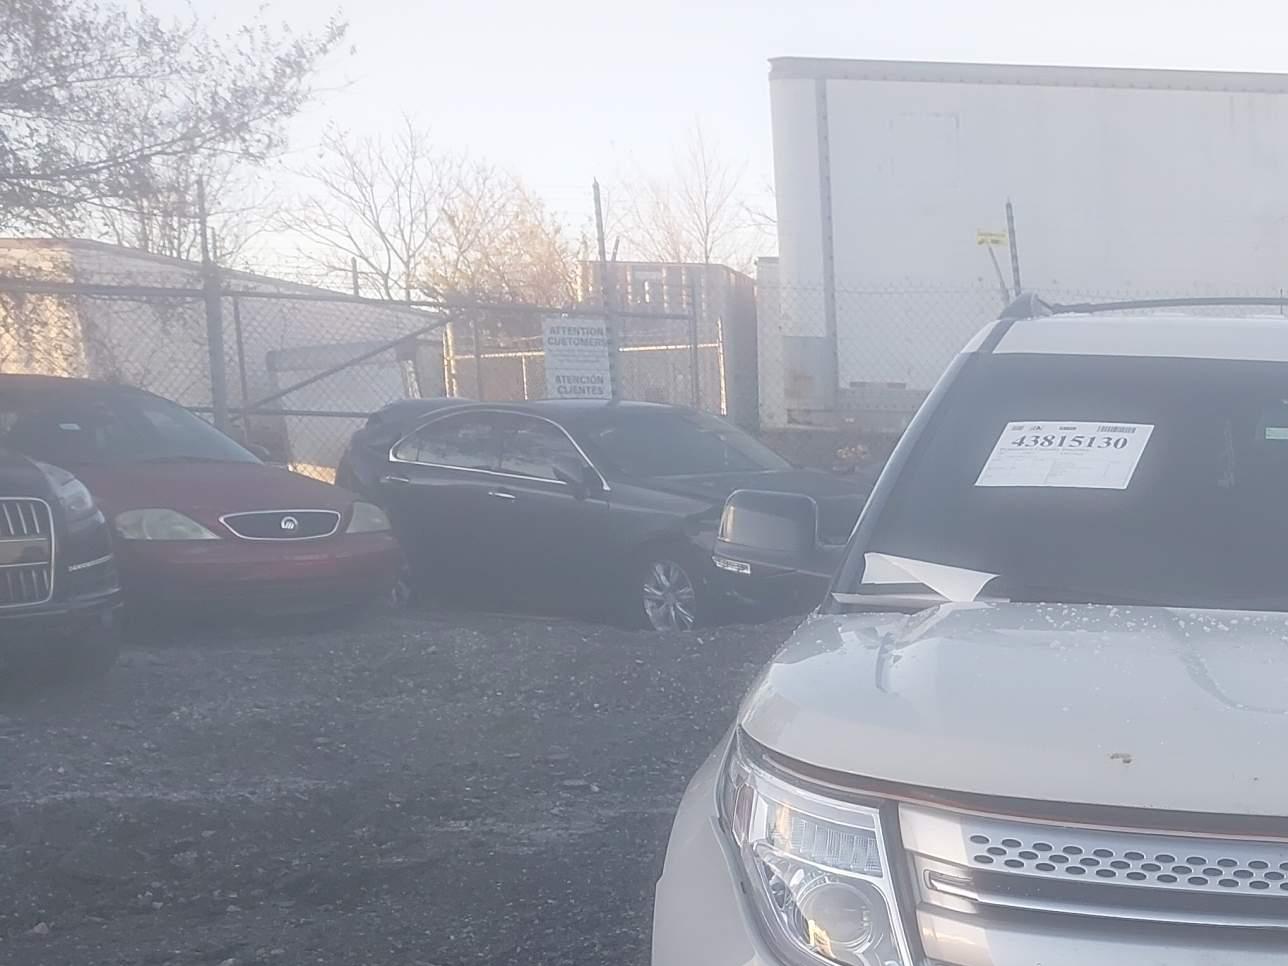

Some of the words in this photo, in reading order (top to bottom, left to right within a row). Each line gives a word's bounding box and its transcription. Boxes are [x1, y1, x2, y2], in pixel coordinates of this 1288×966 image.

[550, 327, 604, 336] ATTENTION
[557, 385, 604, 395] CLIENTES
[1011, 434, 1129, 449] 43815130
